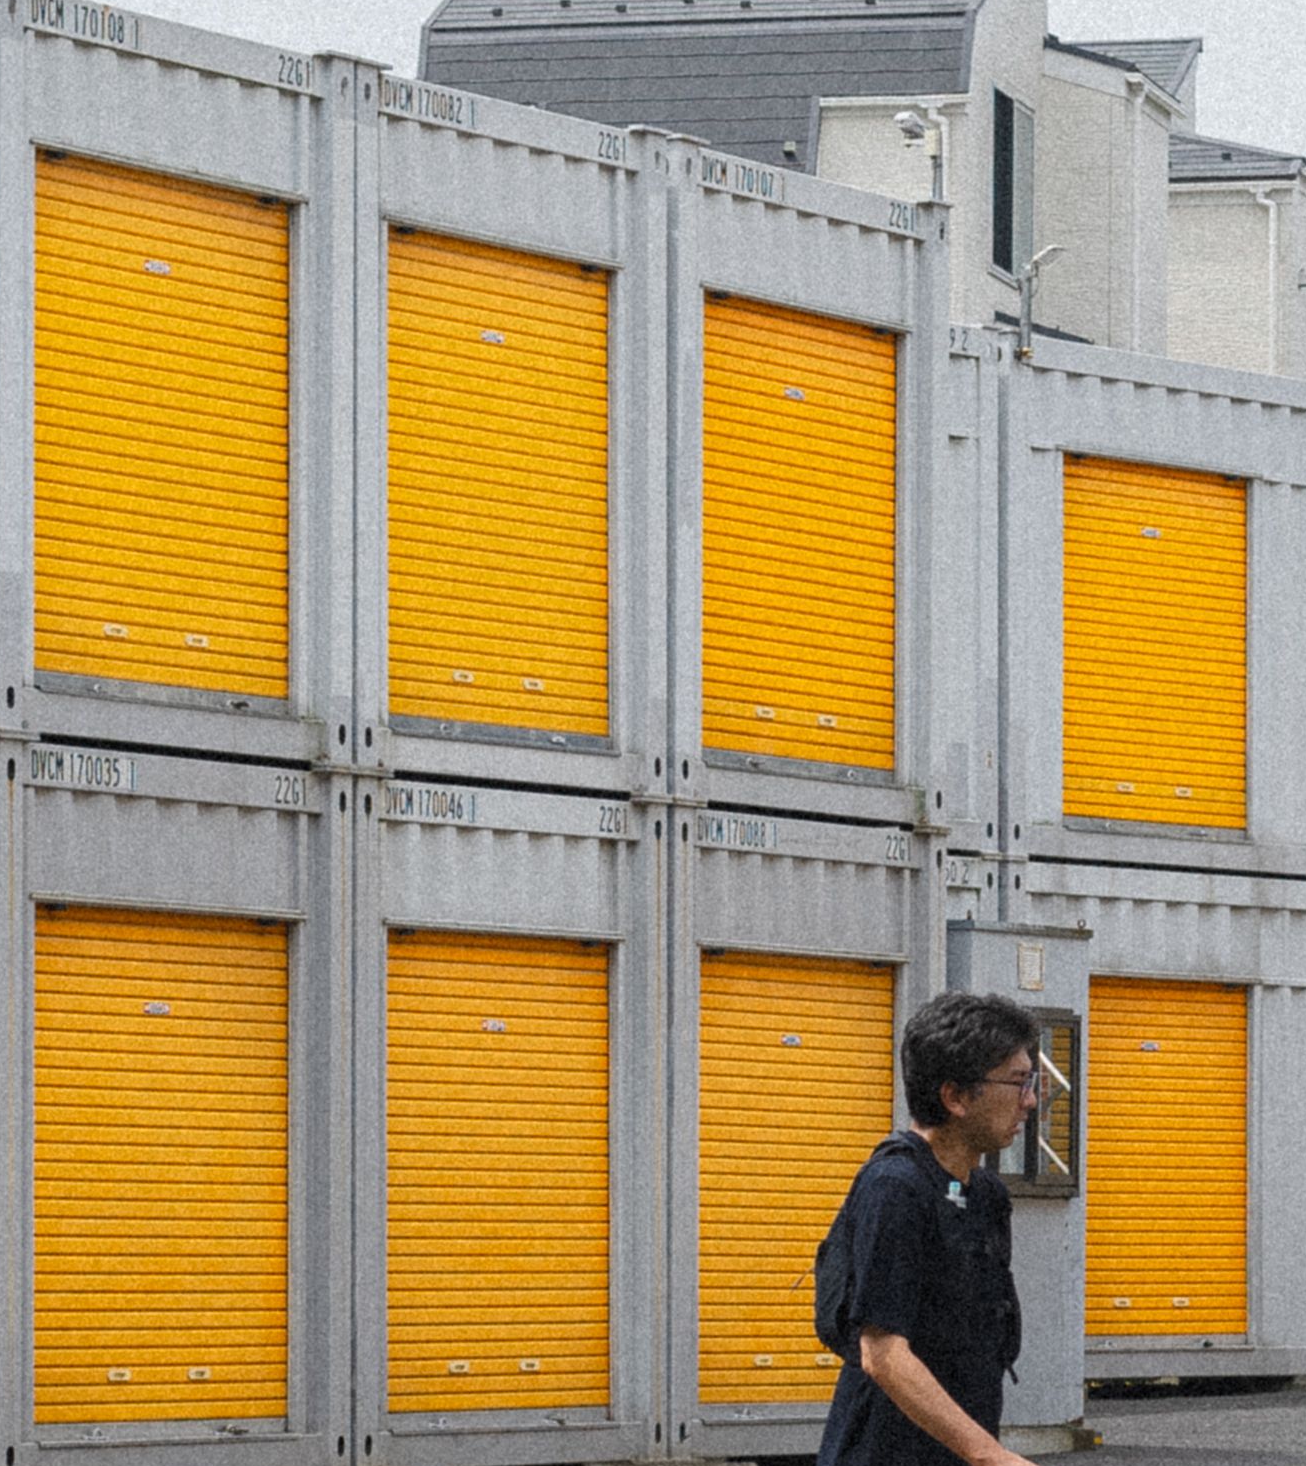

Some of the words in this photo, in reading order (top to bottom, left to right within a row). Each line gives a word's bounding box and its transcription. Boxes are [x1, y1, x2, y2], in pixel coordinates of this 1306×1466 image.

[74, 4, 125, 44] 170108
[278, 54, 311, 89] 22G1
[384, 79, 413, 113] DVCM
[598, 132, 627, 163] 22G1
[702, 155, 728, 187] DVCM
[889, 202, 916, 232] 22G1
[31, 749, 64, 782] DVCM
[69, 753, 121, 787] 170035
[274, 775, 307, 806] 22G1
[385, 785, 414, 816] DVCM
[418, 789, 463, 820] 170046
[599, 806, 628, 834] 22G1
[886, 835, 912, 862] 22G1
